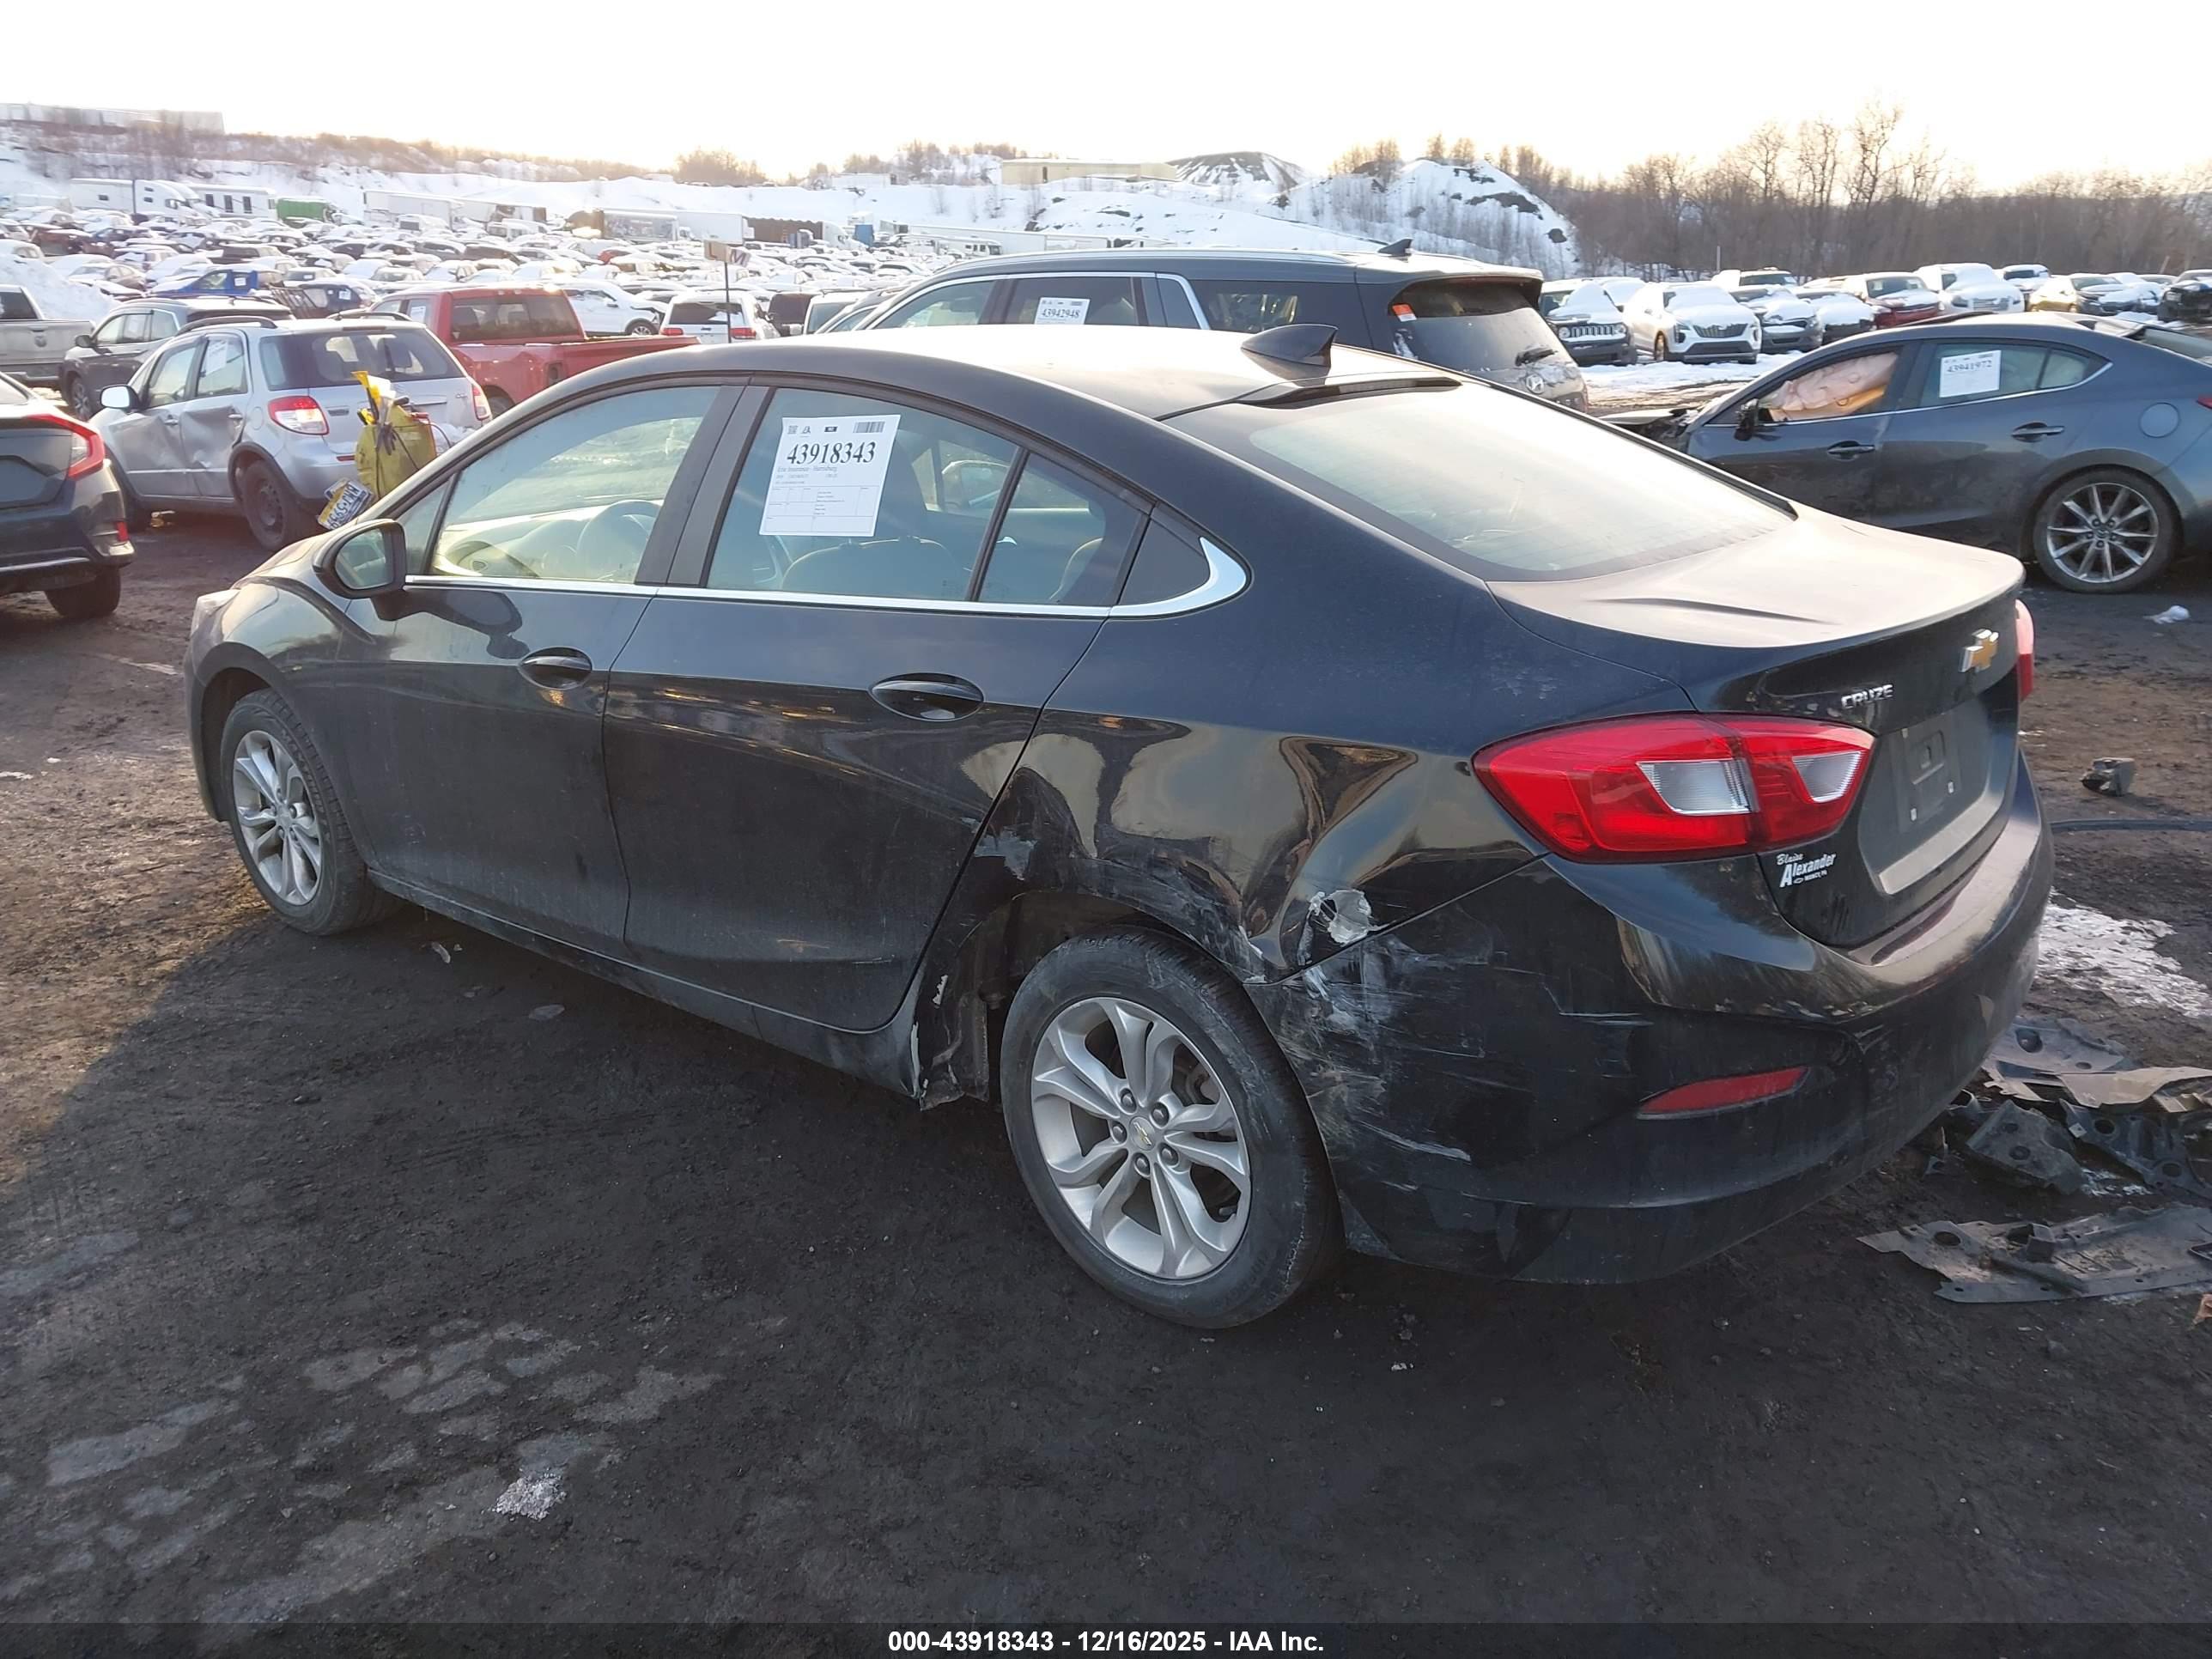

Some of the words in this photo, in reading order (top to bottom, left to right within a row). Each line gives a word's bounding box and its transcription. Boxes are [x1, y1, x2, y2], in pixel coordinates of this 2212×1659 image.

[787, 441, 877, 465] 43918343
[1841, 684, 1893, 709] CRUZE
[1779, 854, 1837, 888] Alexander
